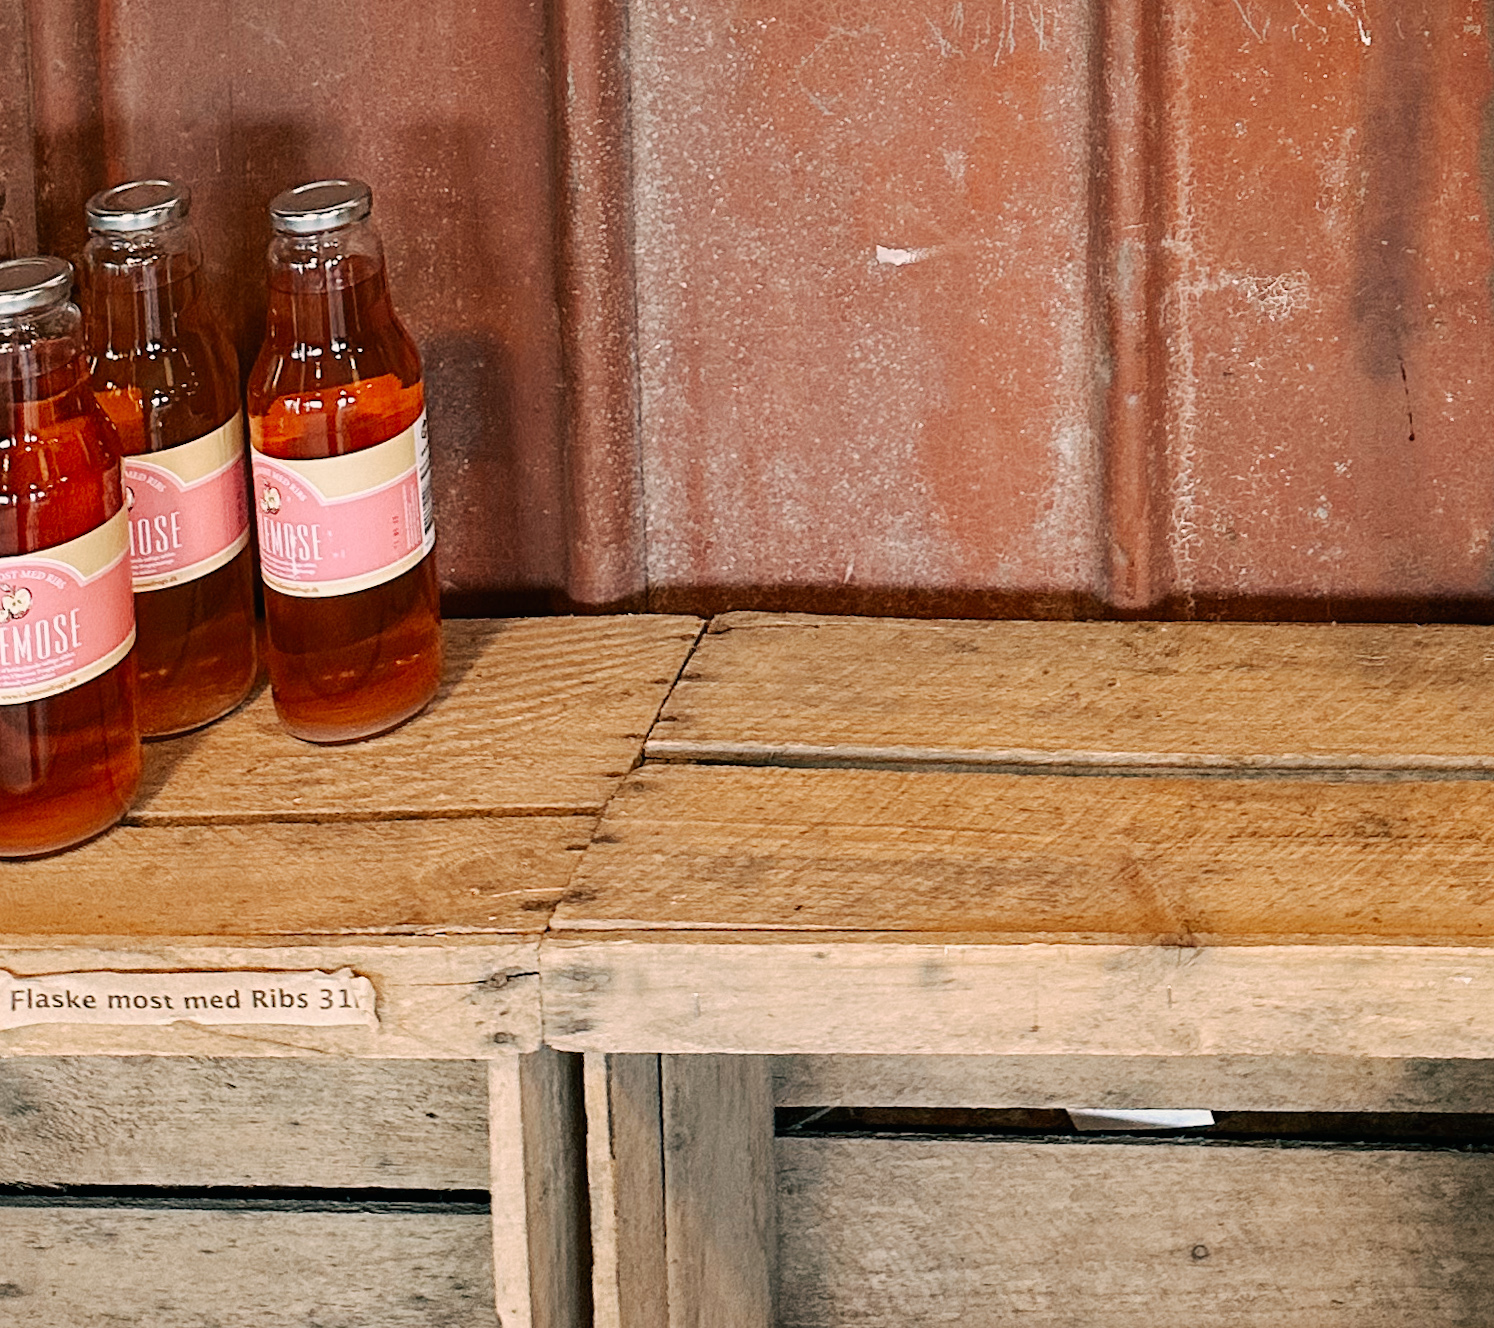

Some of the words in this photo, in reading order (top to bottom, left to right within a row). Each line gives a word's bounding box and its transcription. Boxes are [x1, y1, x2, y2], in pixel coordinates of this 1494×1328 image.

[259, 517, 323, 561] EMOSE
[0, 608, 82, 666] EMOSE
[10, 989, 97, 1012] Flaske
[107, 992, 174, 1010] most
[184, 989, 241, 1009] med
[252, 988, 309, 1010] Ribs
